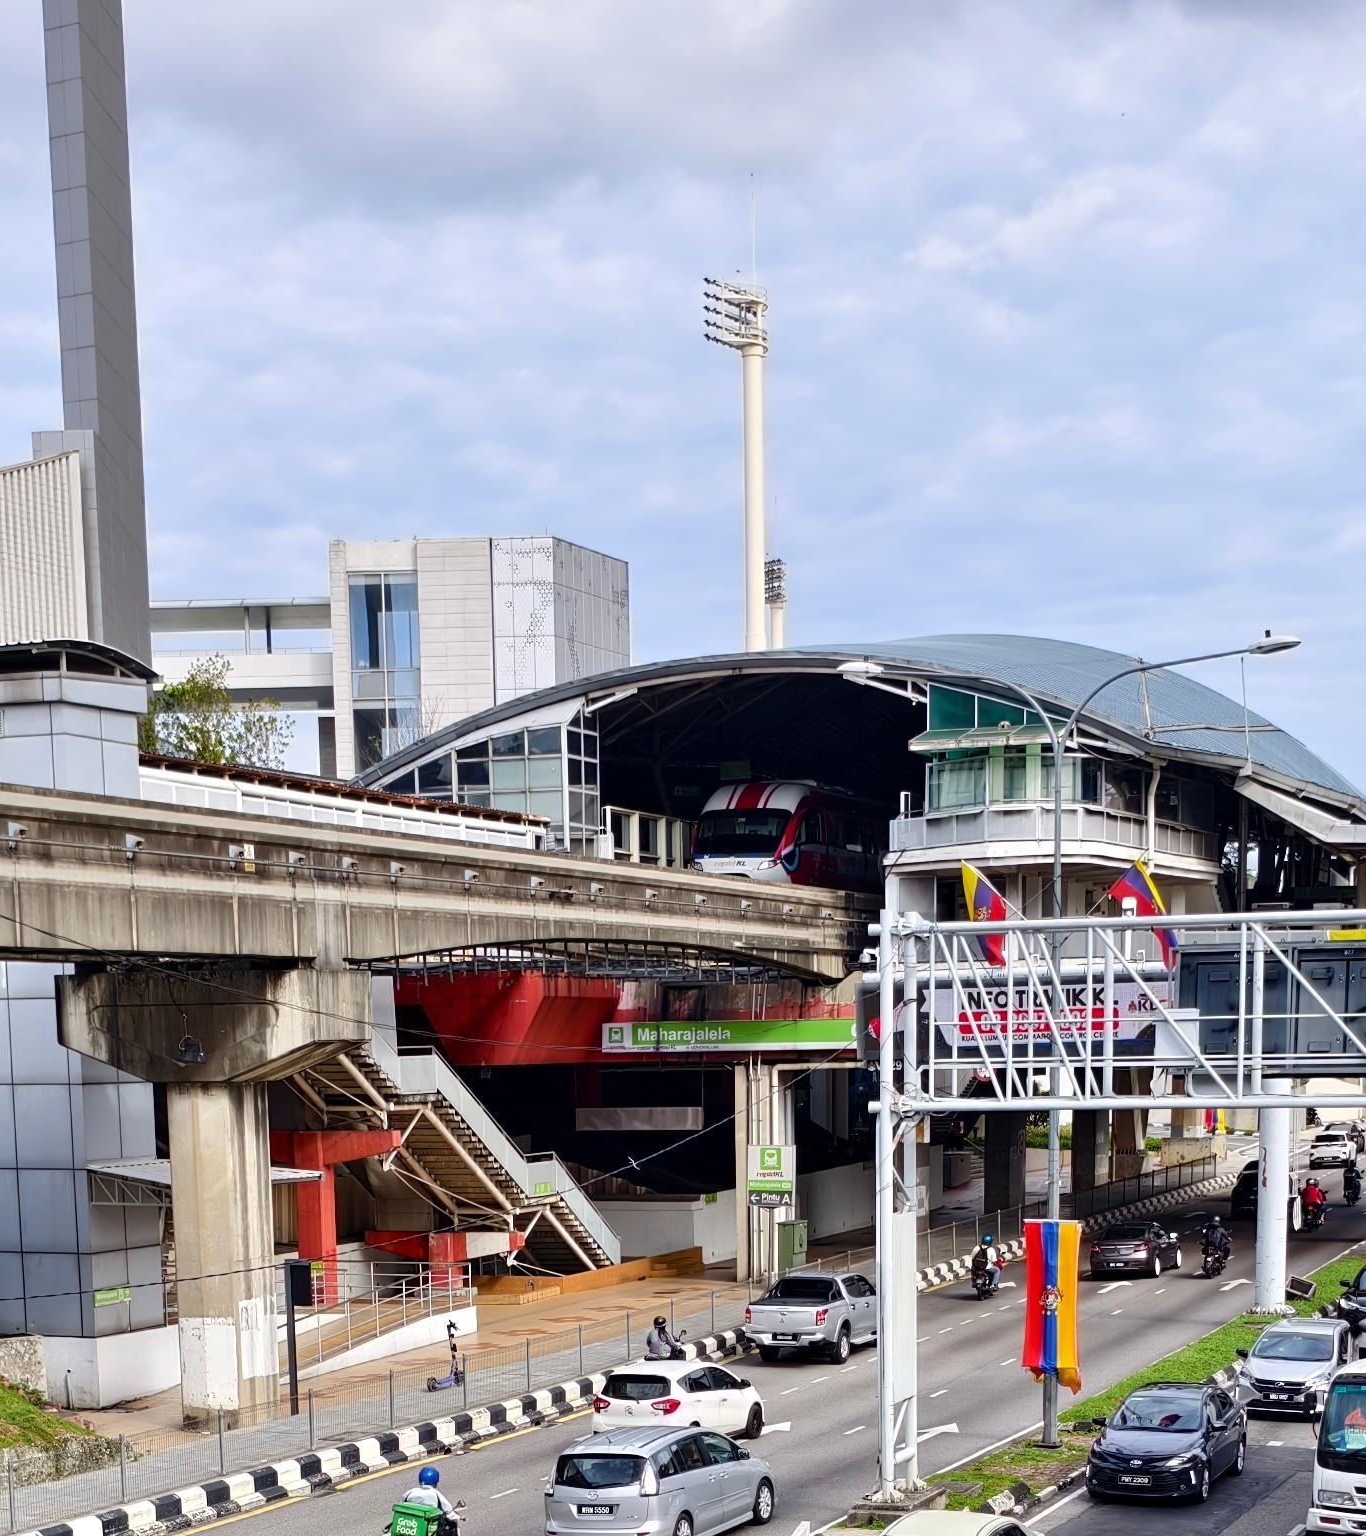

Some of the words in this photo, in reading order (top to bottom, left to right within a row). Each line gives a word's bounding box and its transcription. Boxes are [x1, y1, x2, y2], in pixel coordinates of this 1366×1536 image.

[638, 1027, 731, 1043] Maharajalela
[761, 1193, 780, 1201] Pintu
[782, 1194, 791, 1204] A
[397, 1518, 418, 1528] Grab
[396, 1525, 417, 1536] Food
